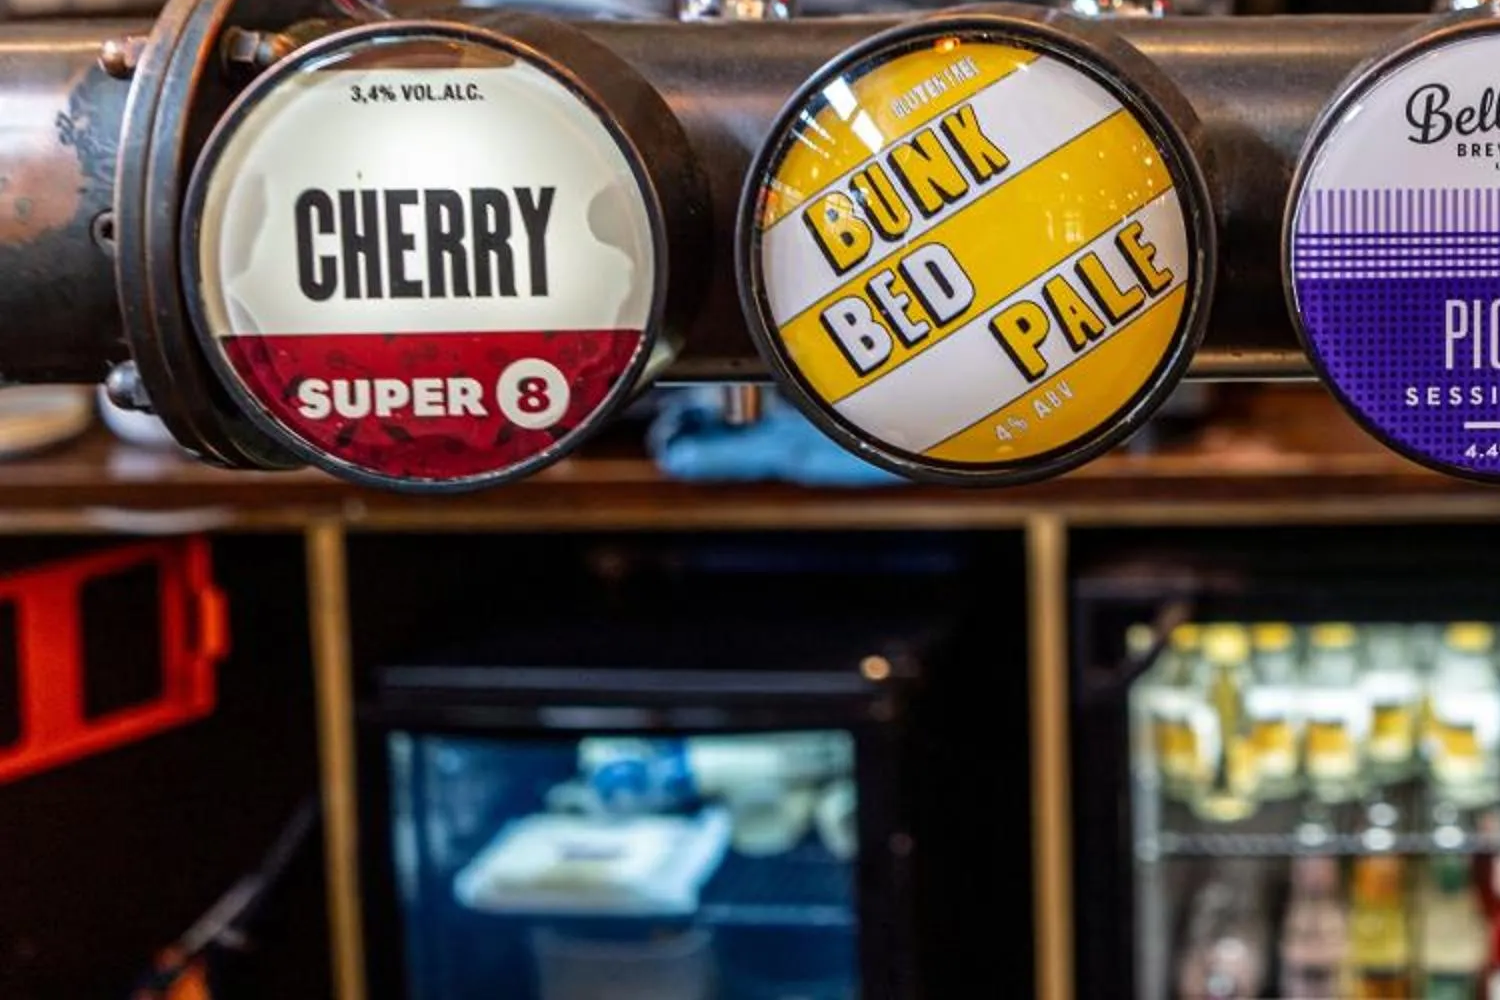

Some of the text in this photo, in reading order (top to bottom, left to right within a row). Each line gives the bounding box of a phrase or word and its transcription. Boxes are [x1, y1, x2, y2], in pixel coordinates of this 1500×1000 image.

[294, 187, 556, 301] CHERRY
[803, 102, 1010, 276] BUNK
[820, 241, 976, 377] BED
[988, 220, 1174, 383] PALE
[298, 377, 488, 420] SUPER
